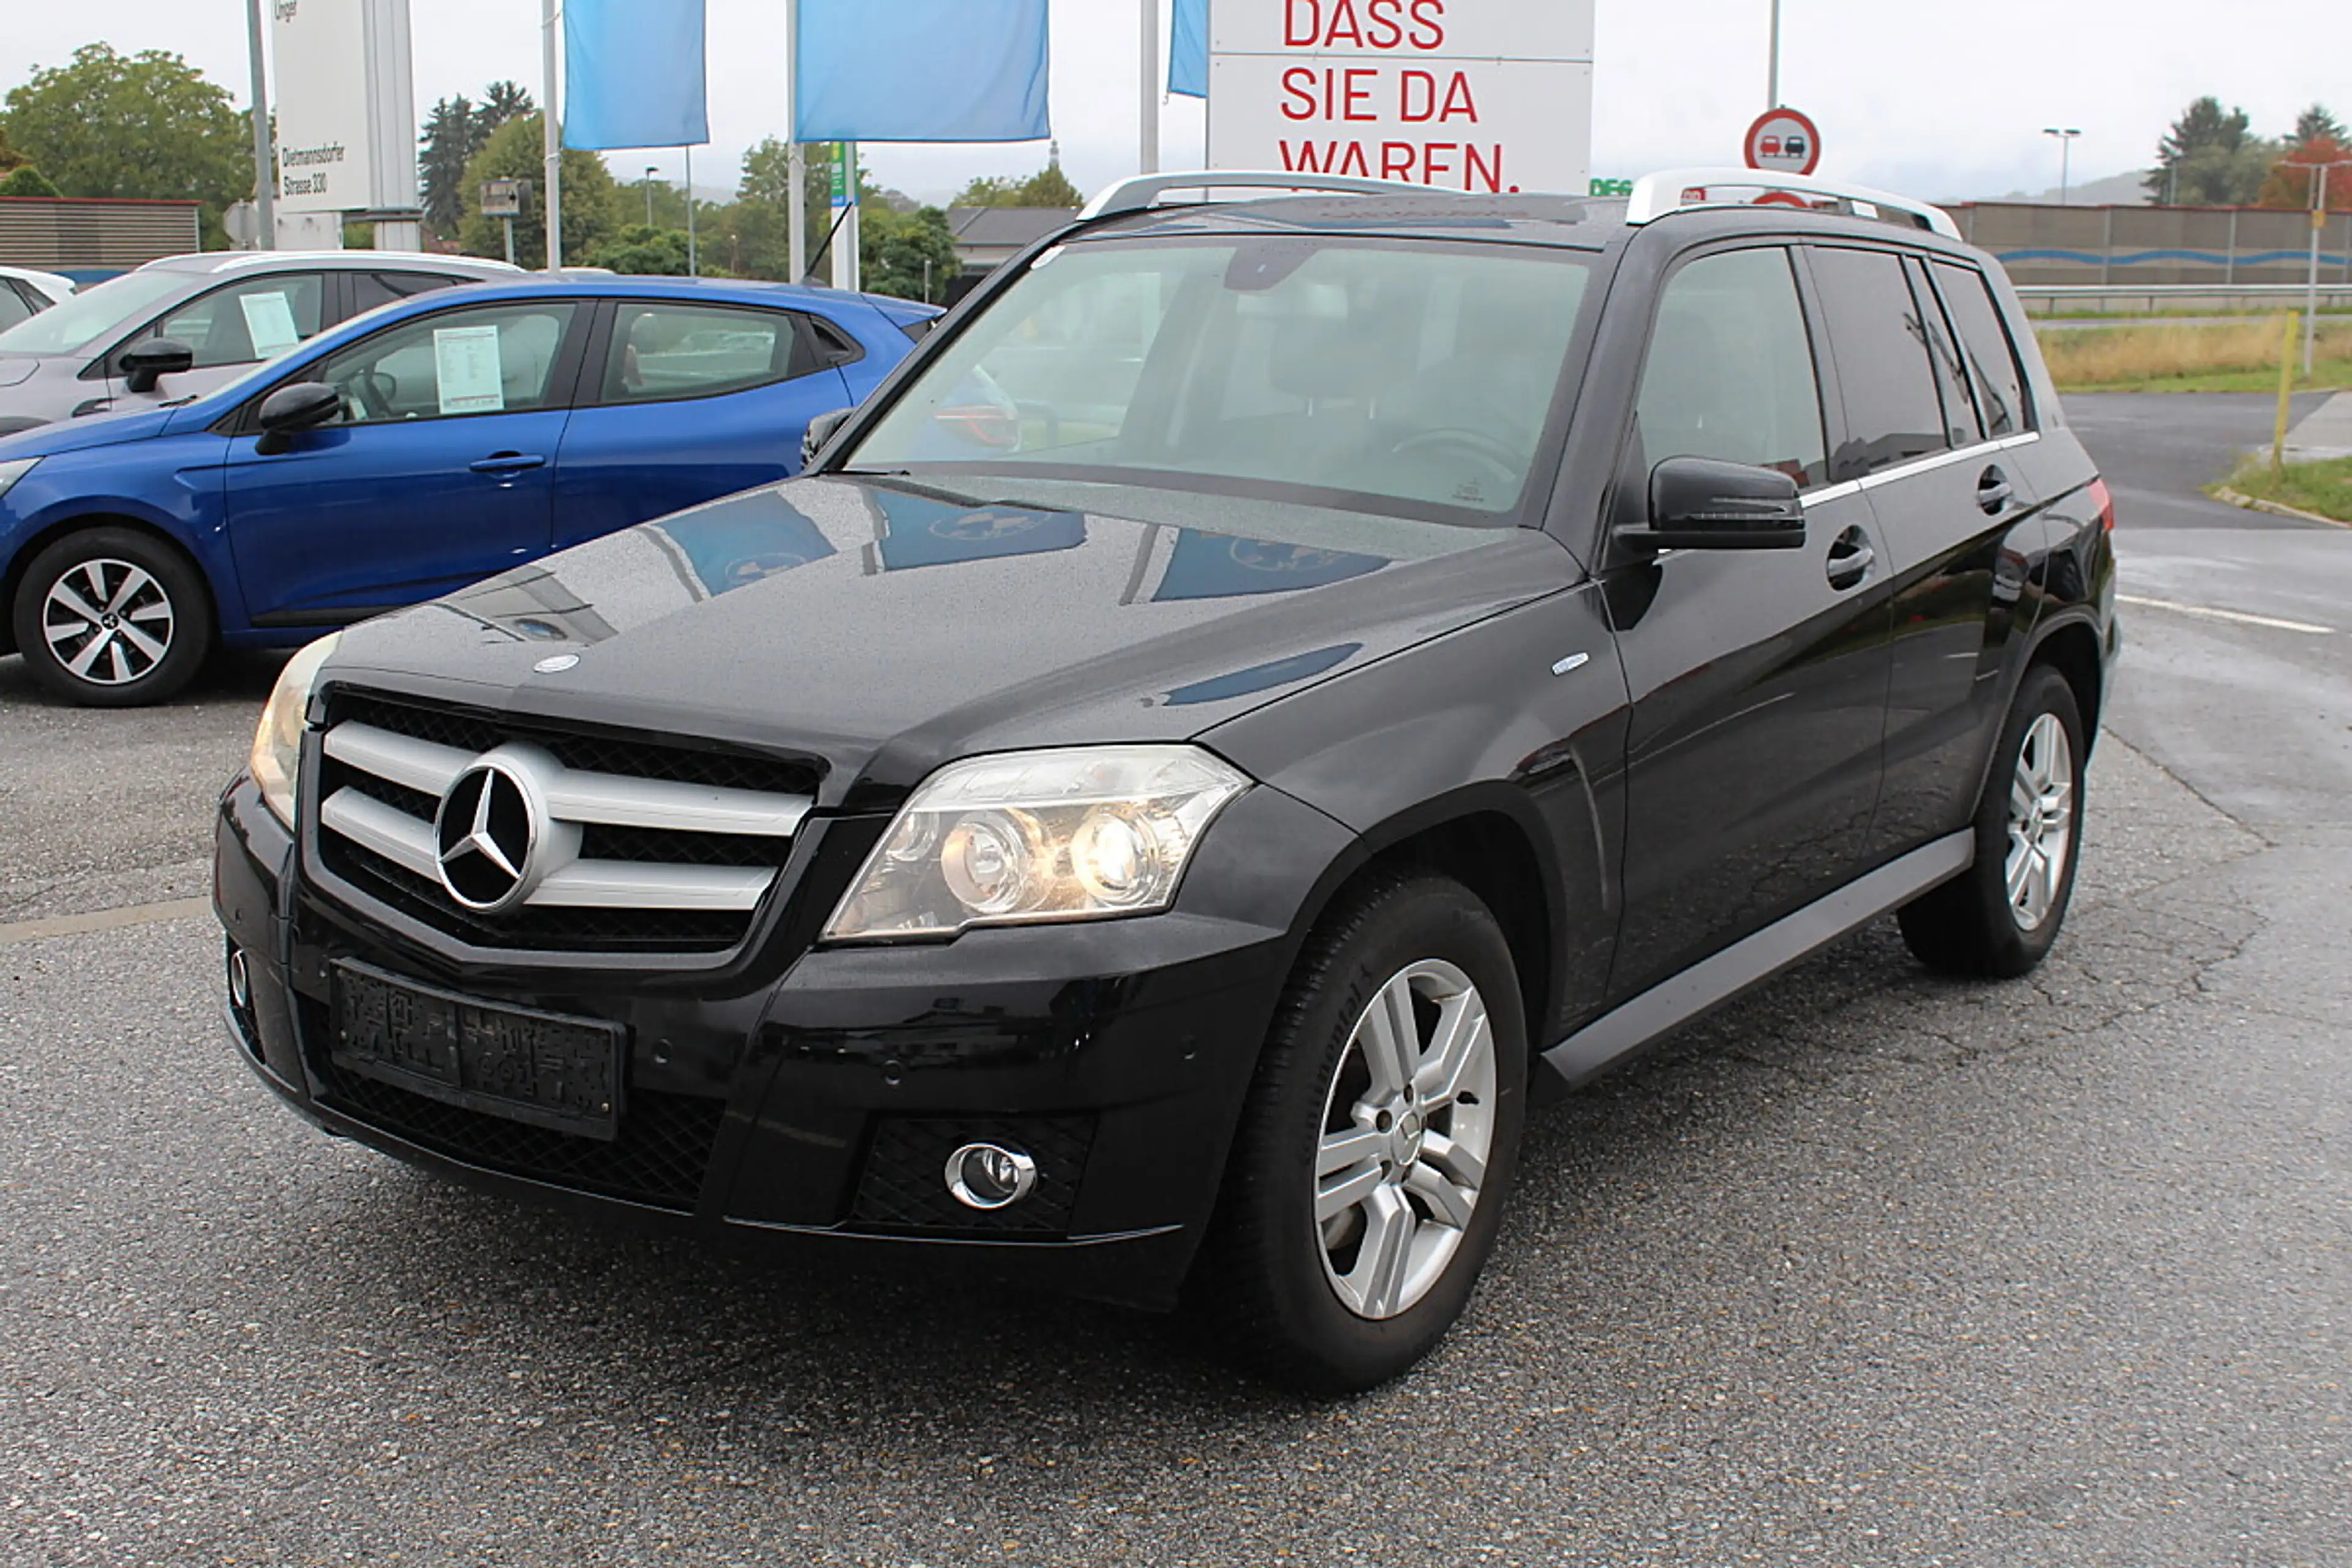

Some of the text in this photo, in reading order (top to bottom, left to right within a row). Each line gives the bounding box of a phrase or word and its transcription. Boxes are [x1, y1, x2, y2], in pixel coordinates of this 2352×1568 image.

[1284, 0, 1444, 50] DASS
[1280, 67, 1478, 123] SIE DA
